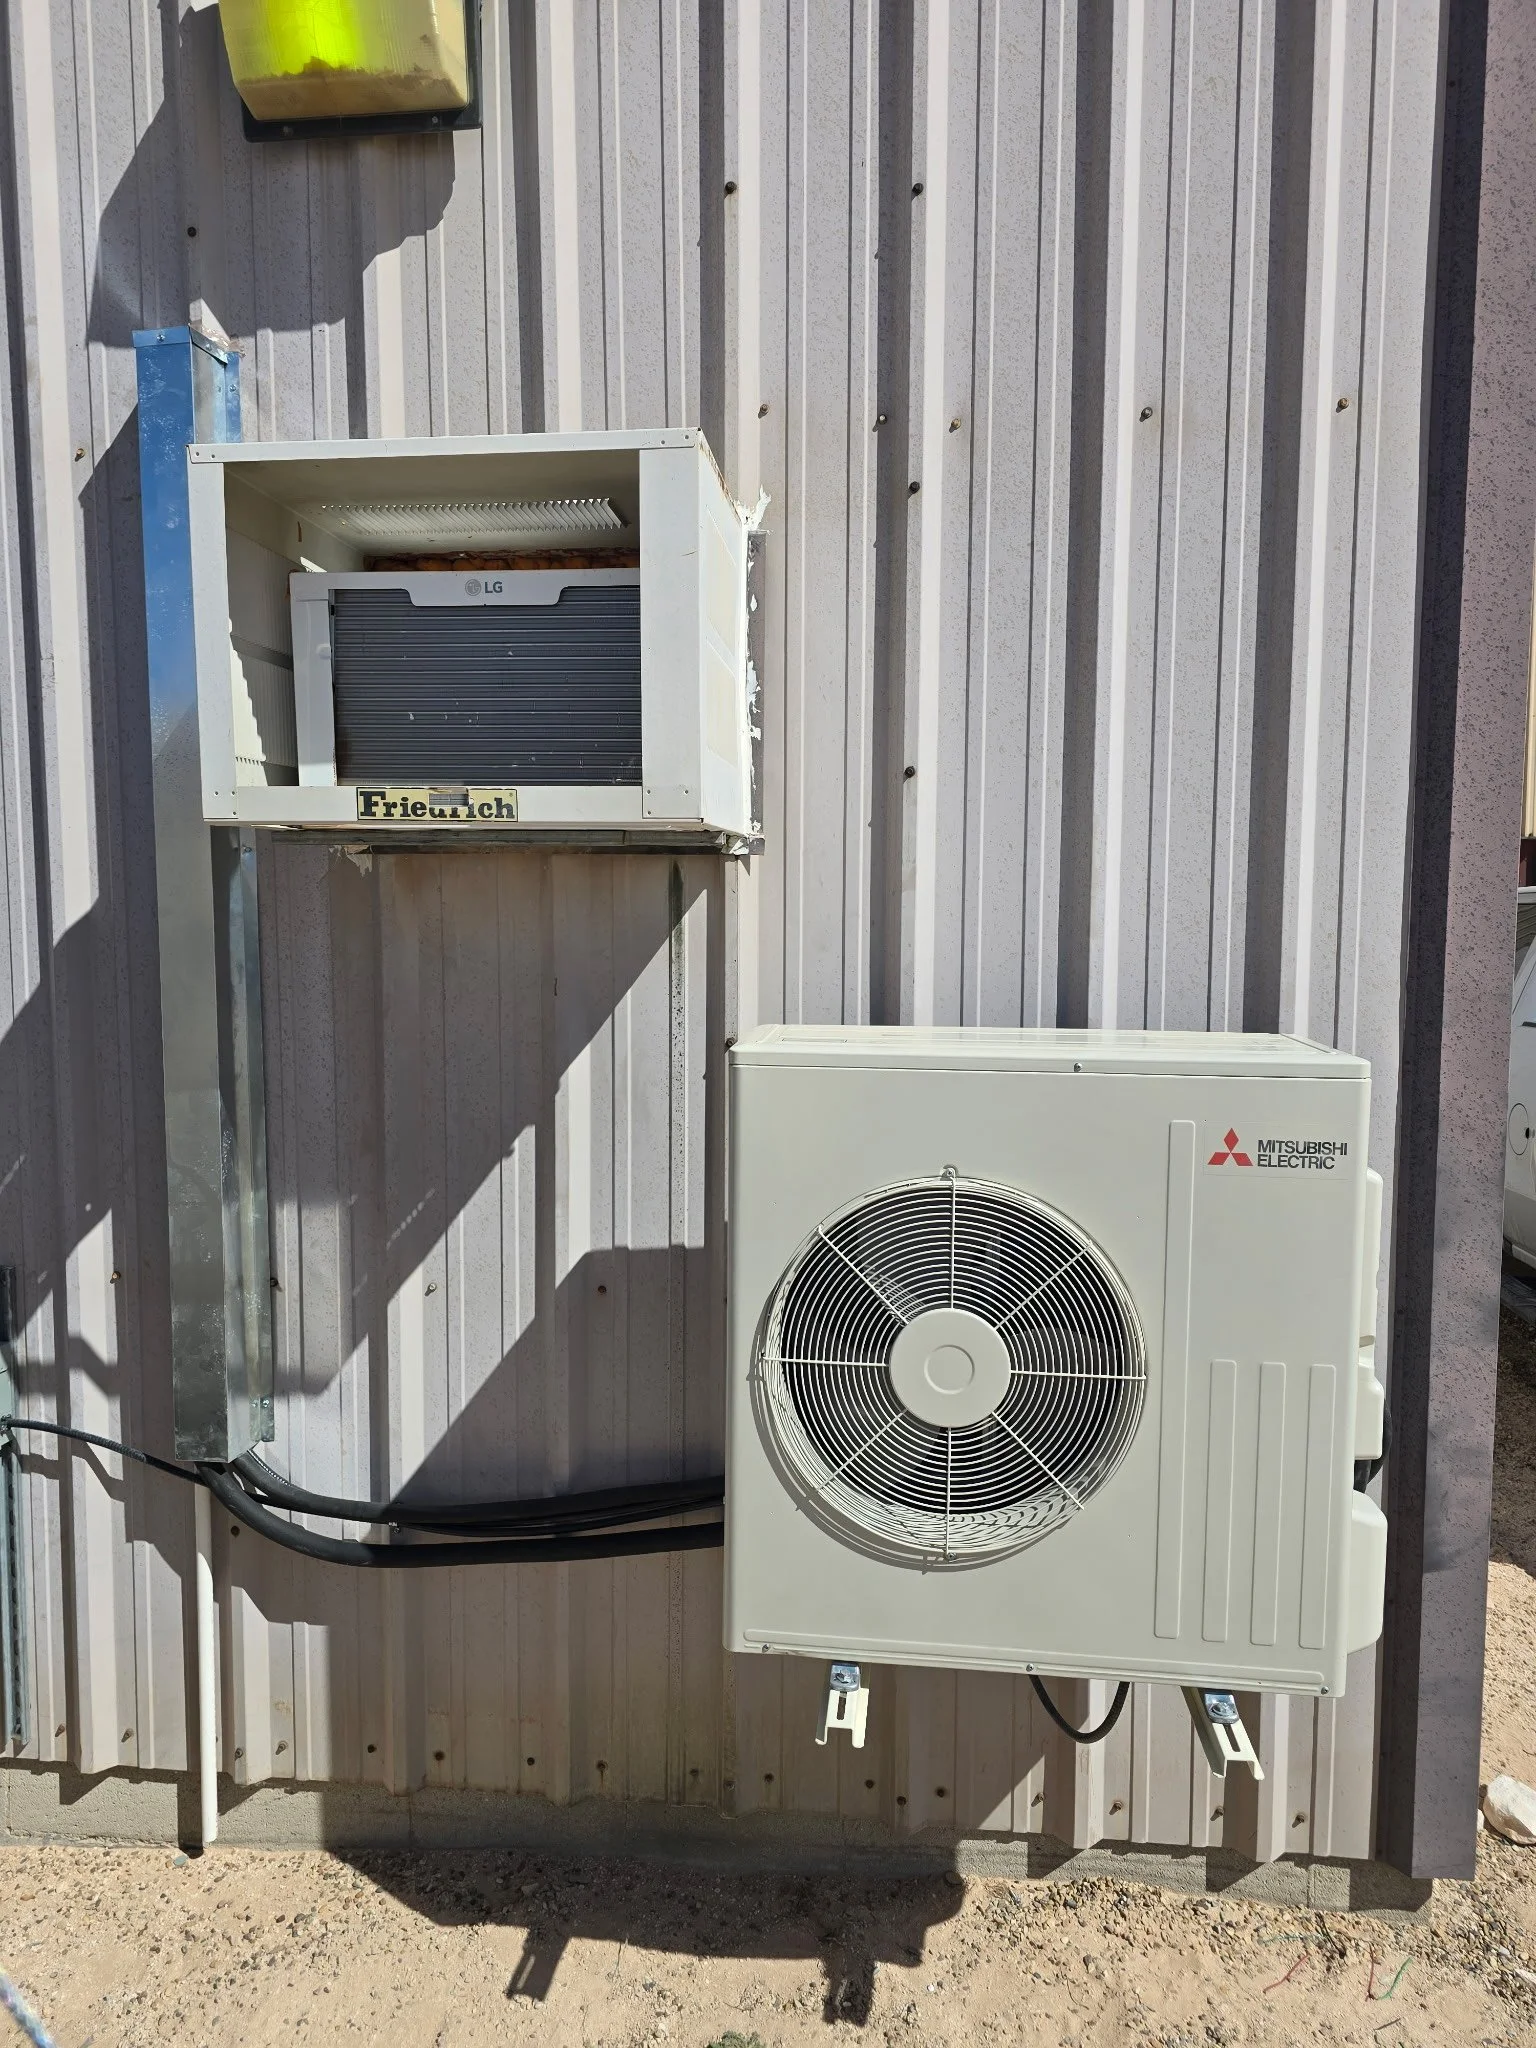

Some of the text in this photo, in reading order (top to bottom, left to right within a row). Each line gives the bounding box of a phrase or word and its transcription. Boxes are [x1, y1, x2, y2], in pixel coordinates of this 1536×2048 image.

[484, 581, 503, 594] LG
[1257, 1139, 1348, 1156] MITSUBISHI
[1257, 1153, 1335, 1170] ELECTRIC
